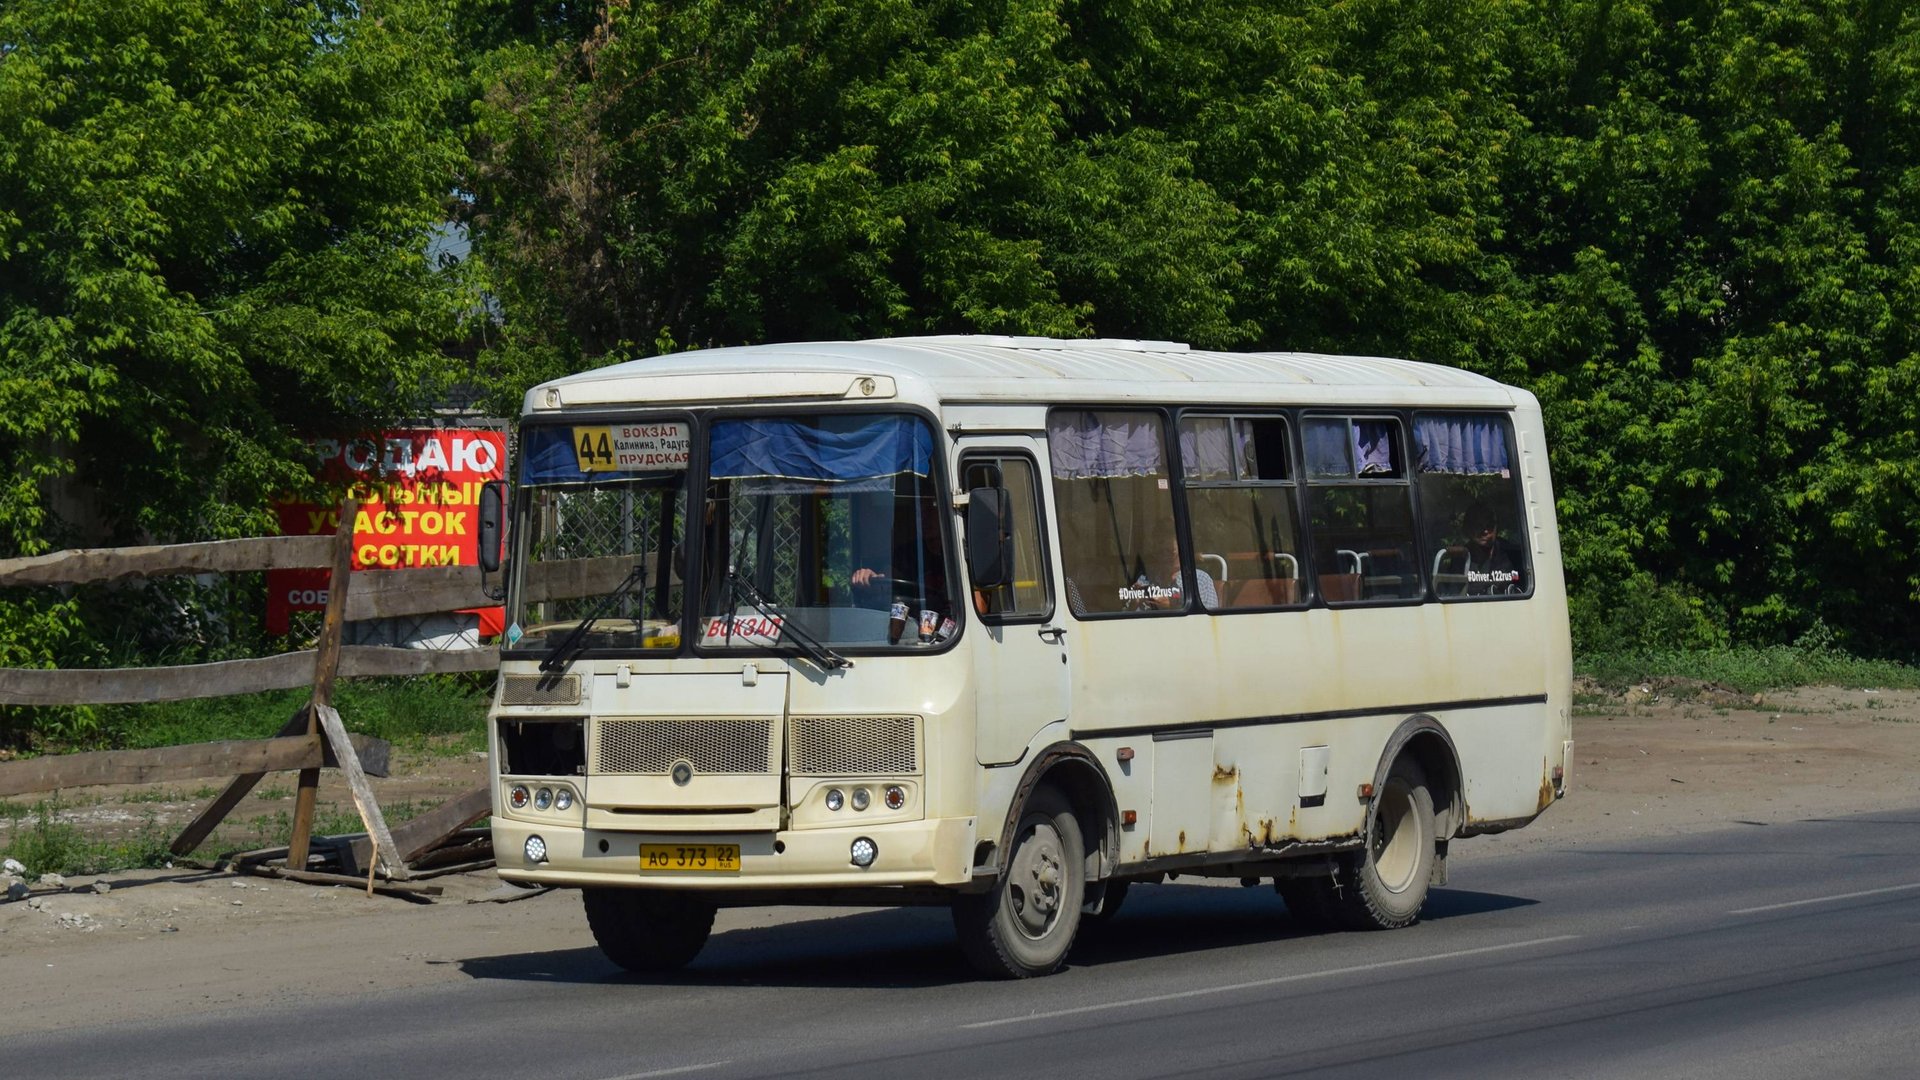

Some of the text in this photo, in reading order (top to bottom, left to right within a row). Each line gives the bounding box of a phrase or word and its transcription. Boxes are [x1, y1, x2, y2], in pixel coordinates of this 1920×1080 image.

[623, 427, 677, 438] ВОКЗАЛ
[580, 433, 612, 464] 44
[614, 439, 689, 451] Калинина, Радуга
[316, 438, 498, 478] РОДАЮ
[619, 453, 689, 465] ПРУДСКАЯ
[359, 544, 460, 566] СОТКИ
[707, 618, 783, 637] ВОКЗАЛ
[676, 848, 707, 866] 373
[717, 847, 733, 862] 22
